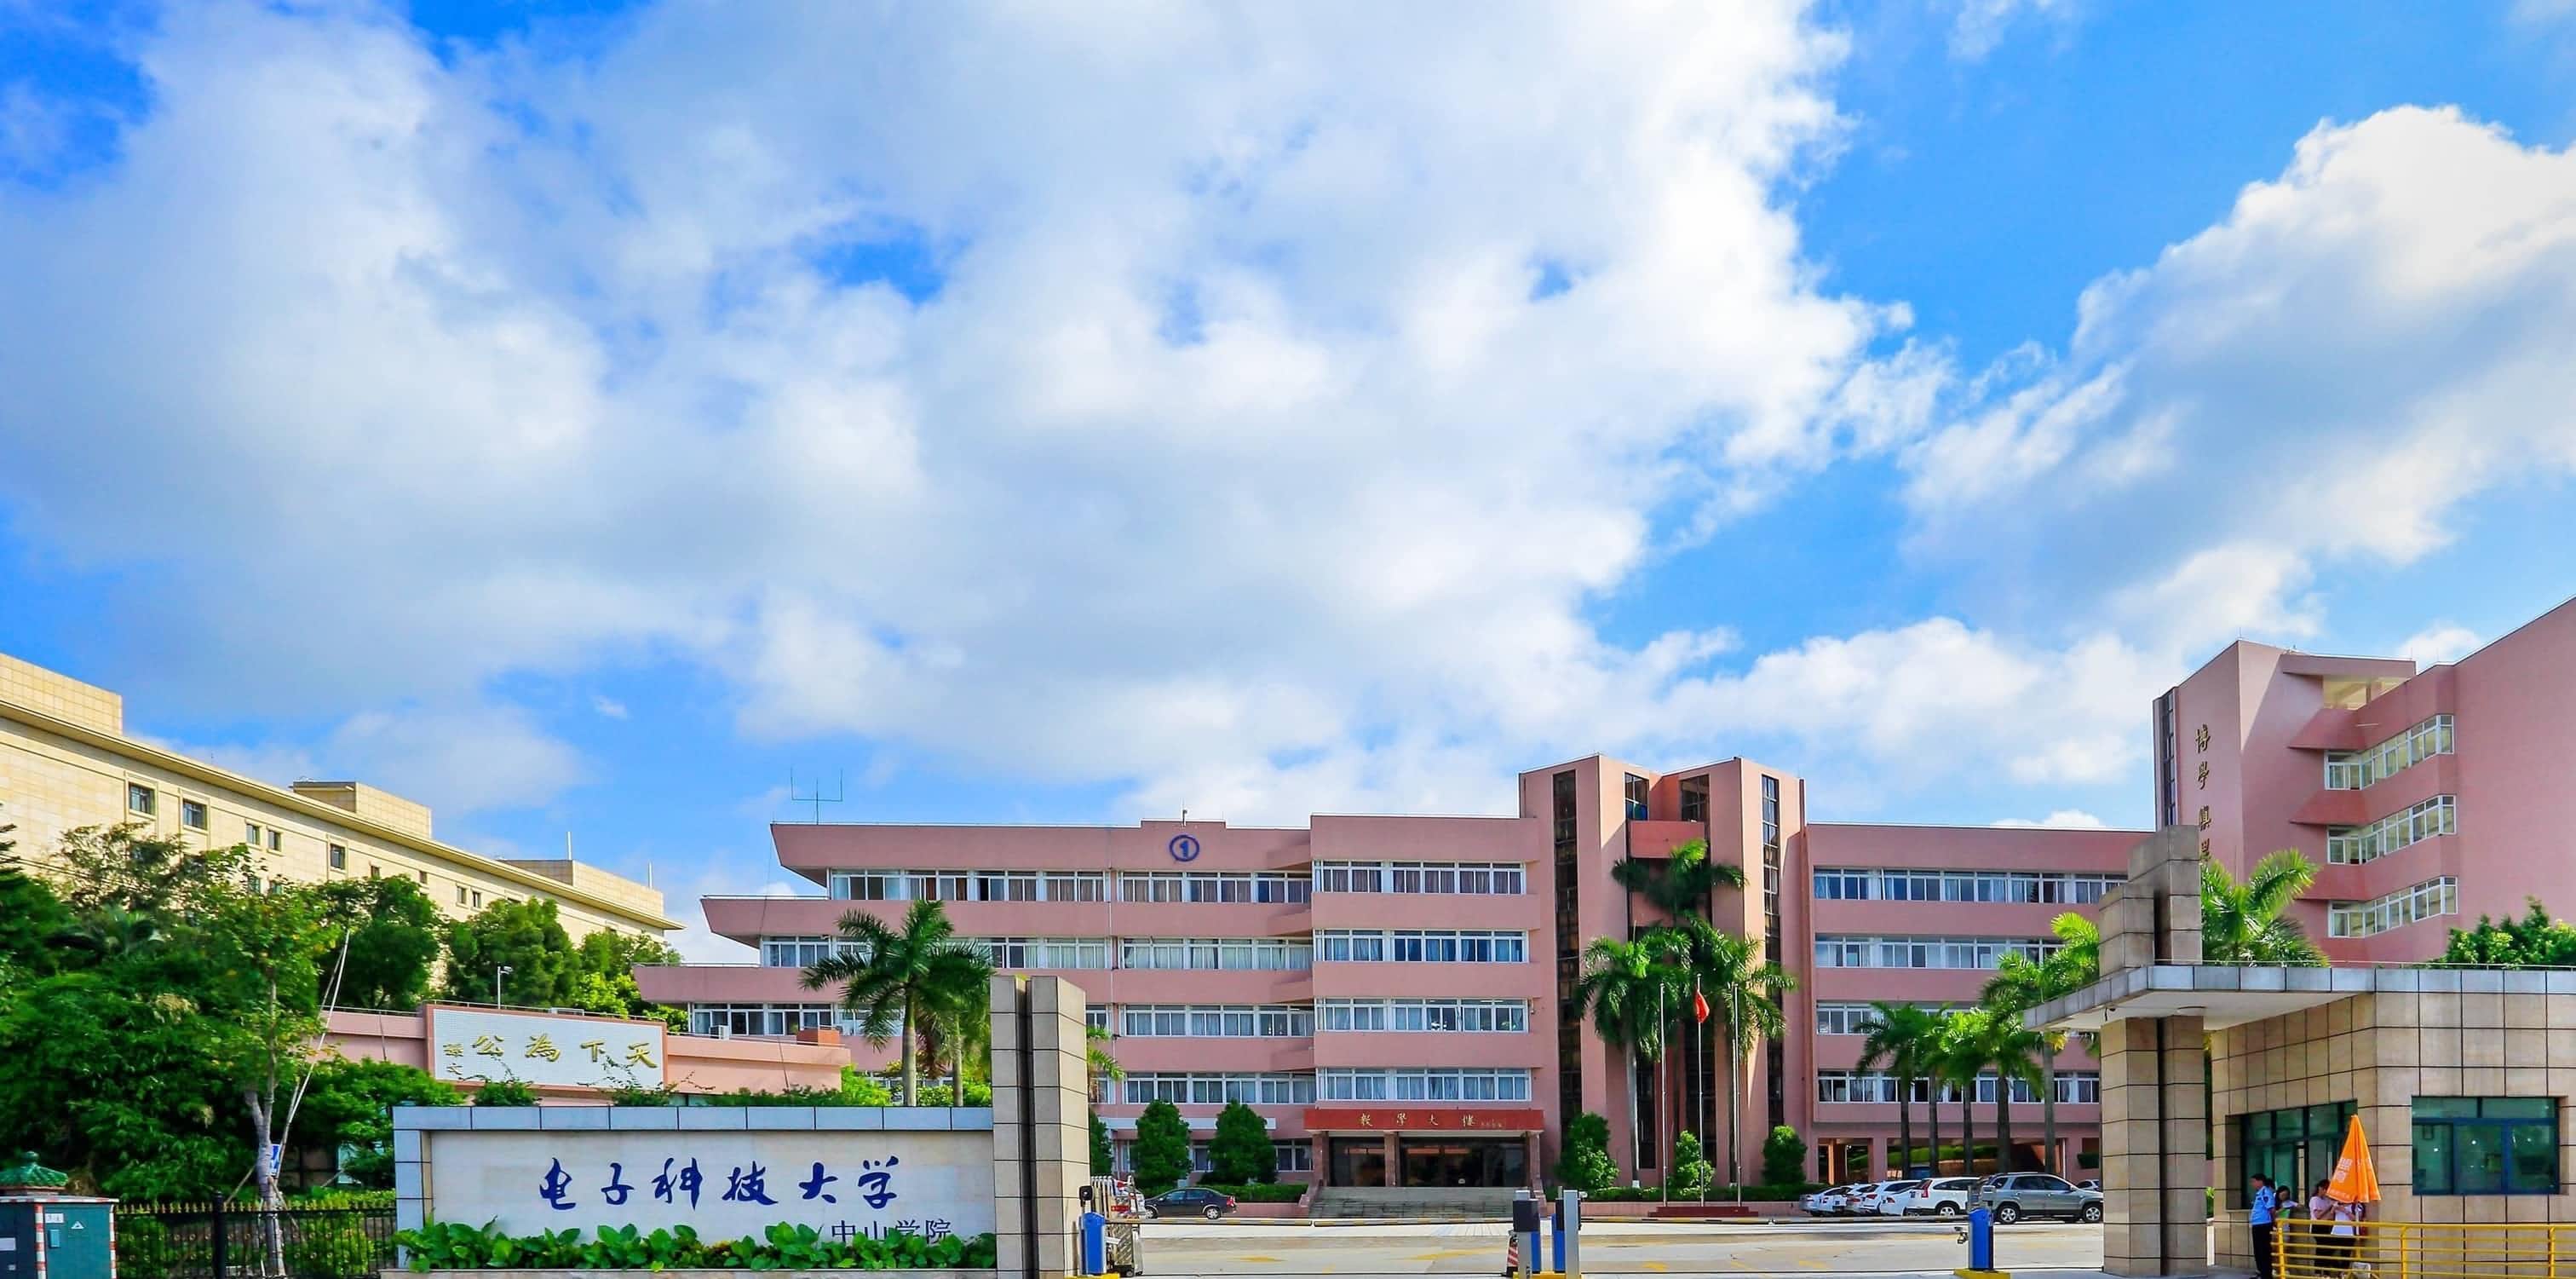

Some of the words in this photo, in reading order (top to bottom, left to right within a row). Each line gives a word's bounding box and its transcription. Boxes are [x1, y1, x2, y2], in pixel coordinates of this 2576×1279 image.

[539, 1155, 900, 1211] 电子科技大学
[831, 1218, 952, 1245] 中山学院
